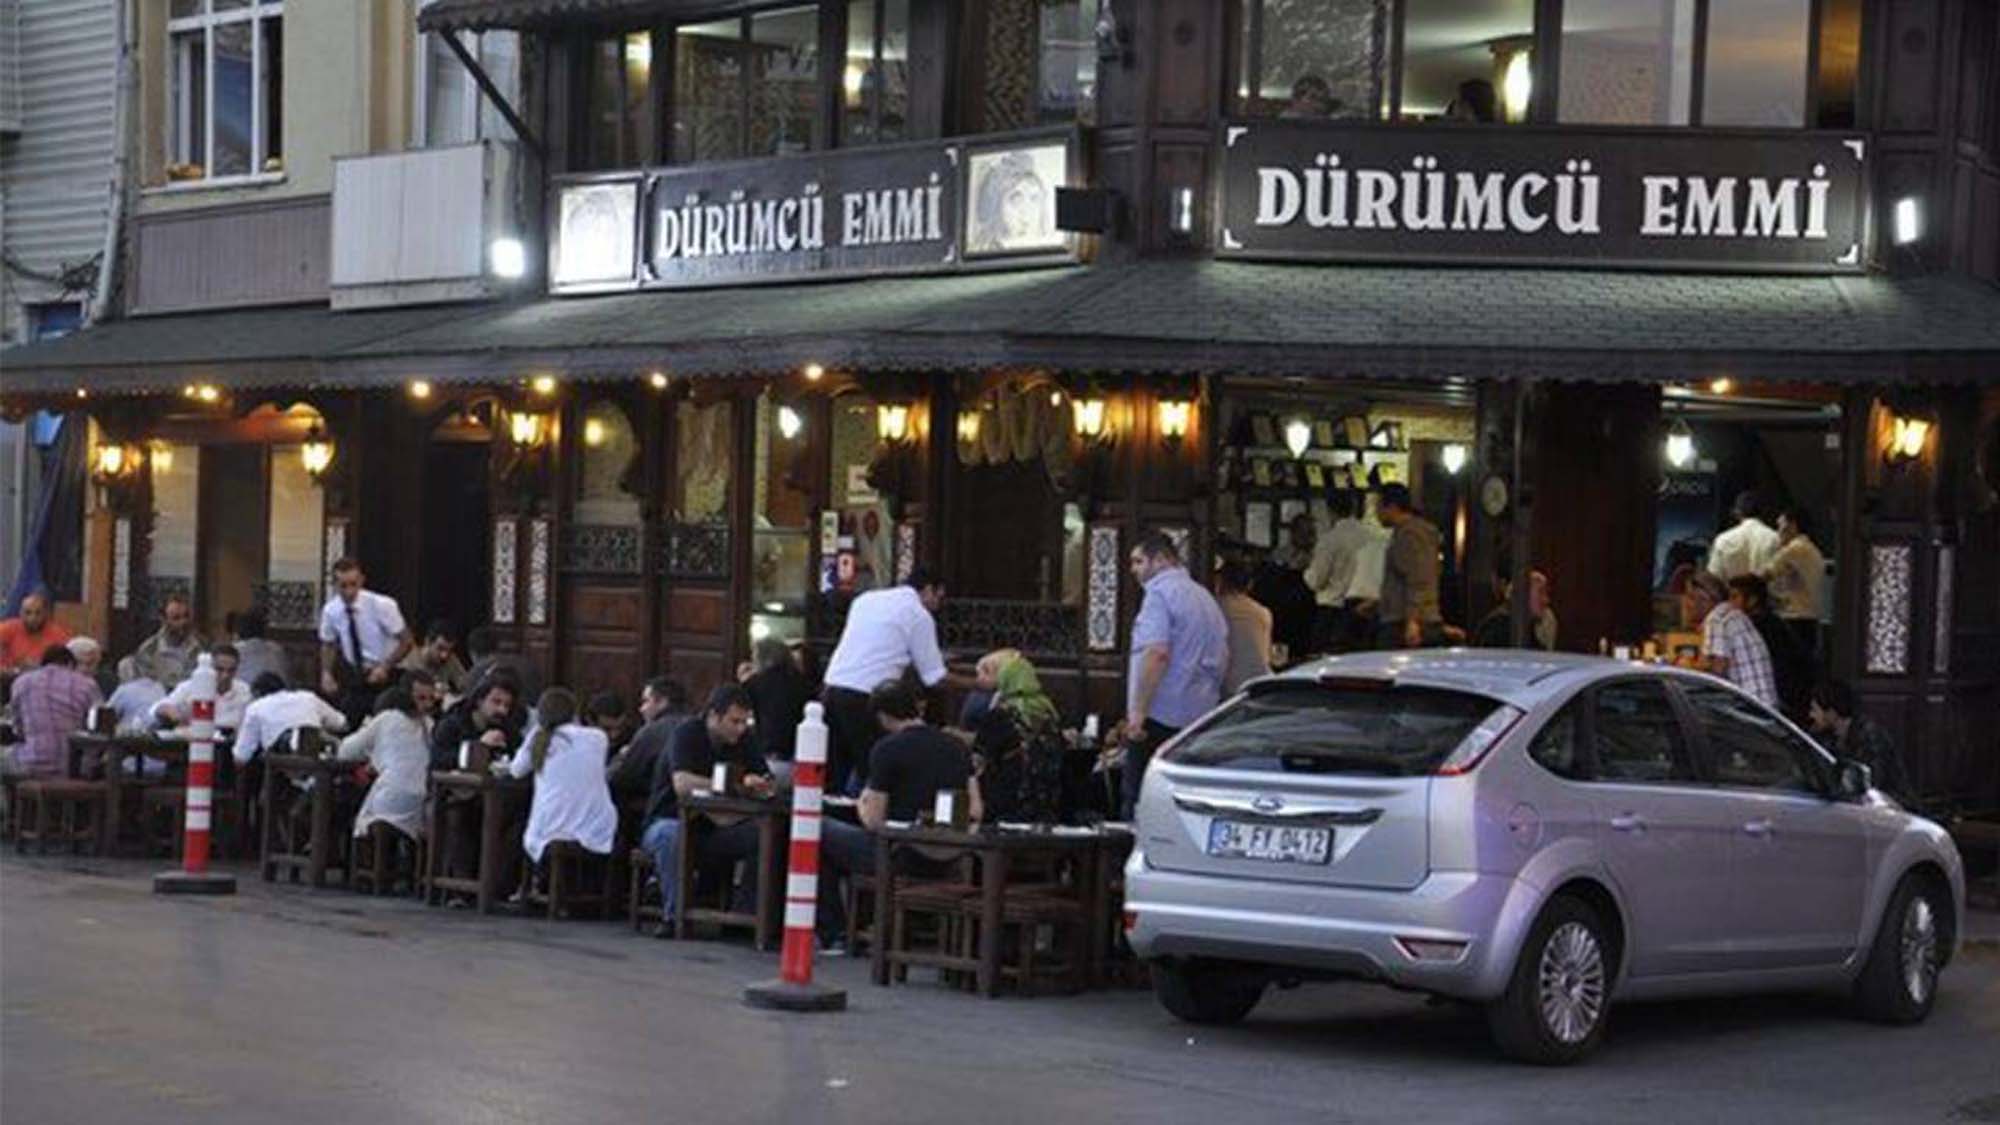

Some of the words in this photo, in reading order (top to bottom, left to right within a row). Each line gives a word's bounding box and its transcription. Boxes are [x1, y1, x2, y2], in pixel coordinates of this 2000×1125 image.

[658, 182, 824, 259] DÜRÜMCÜ
[842, 172, 942, 246] EMMİ
[1256, 153, 1600, 234] DÜRÜMCÜ
[1641, 164, 1830, 238] EMMİ
[1221, 823, 1243, 847] 34
